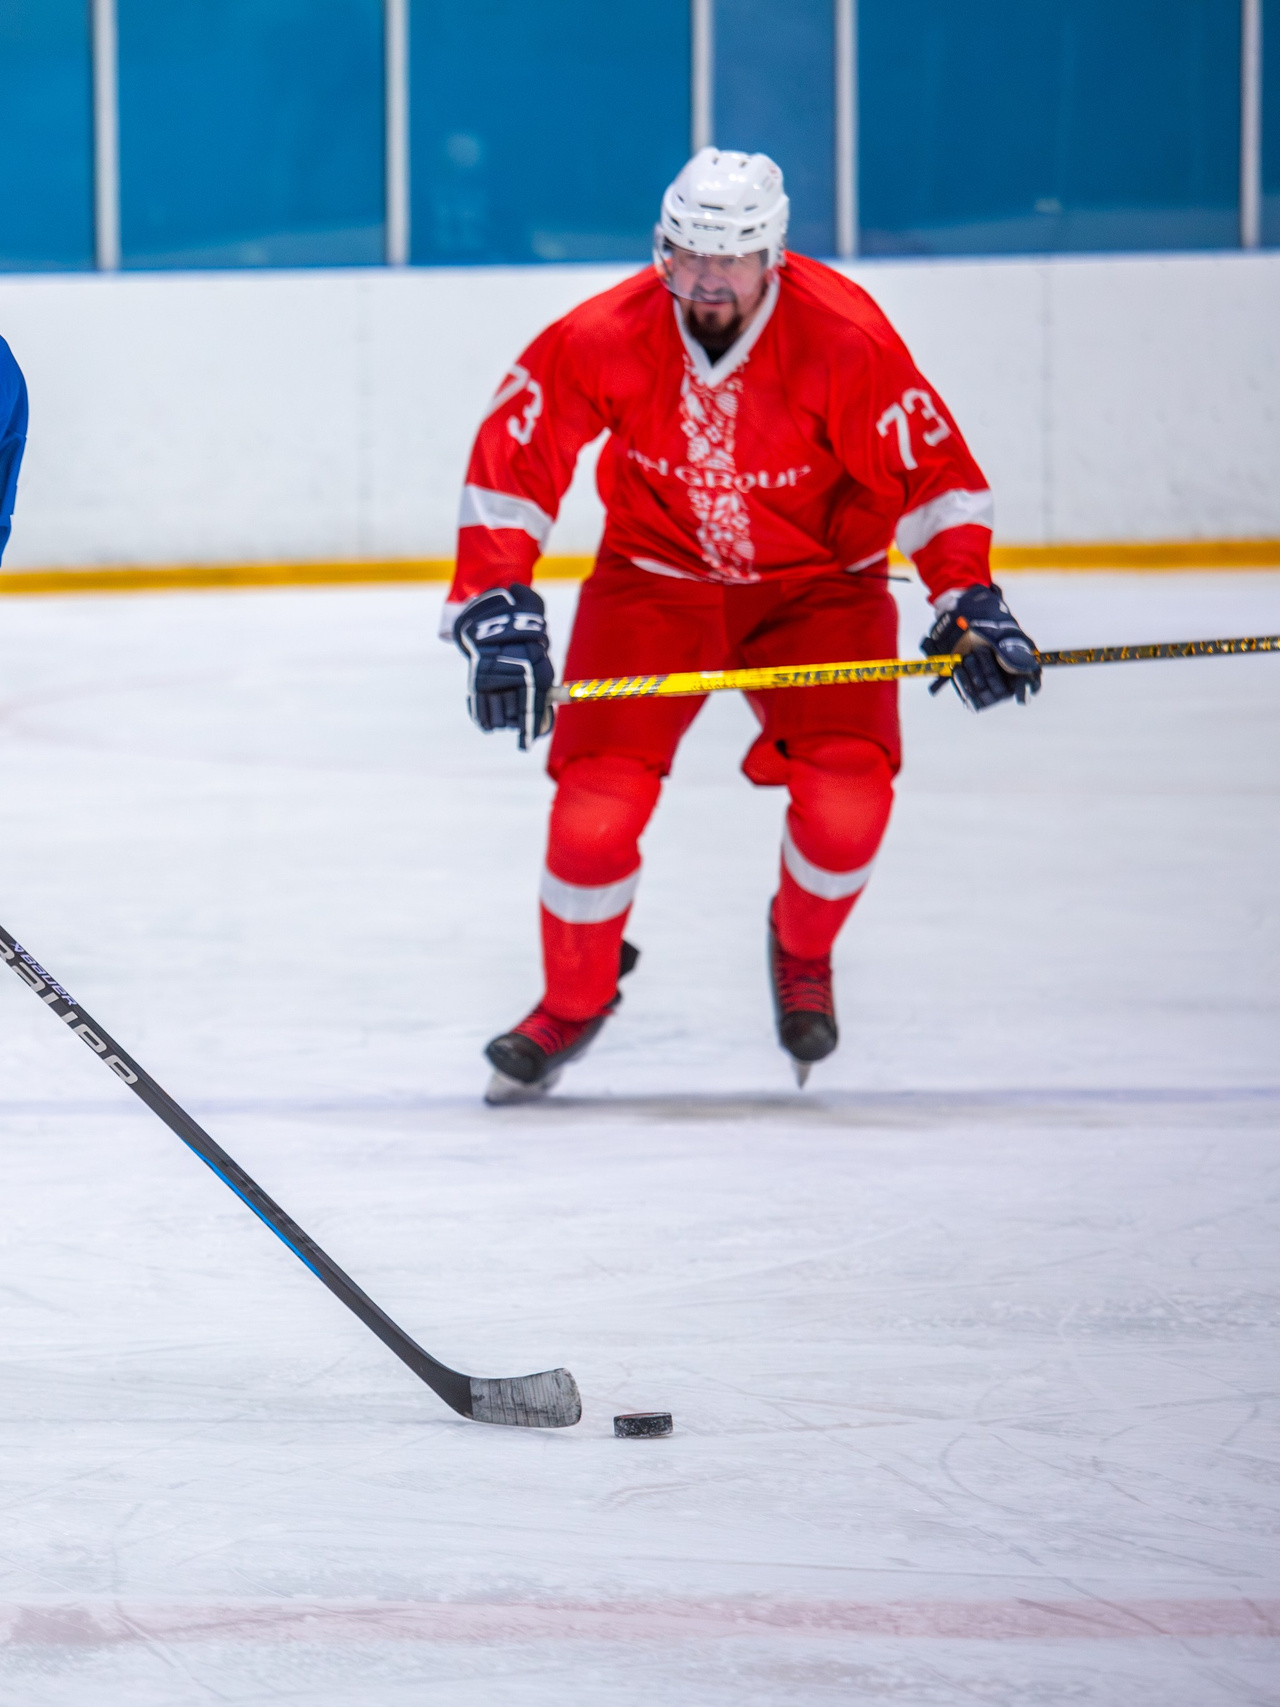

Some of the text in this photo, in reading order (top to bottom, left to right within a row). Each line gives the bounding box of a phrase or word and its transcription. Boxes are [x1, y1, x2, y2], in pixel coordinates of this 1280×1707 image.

[482, 364, 543, 445] 73
[876, 387, 951, 470] 73
[476, 612, 545, 640] CC
